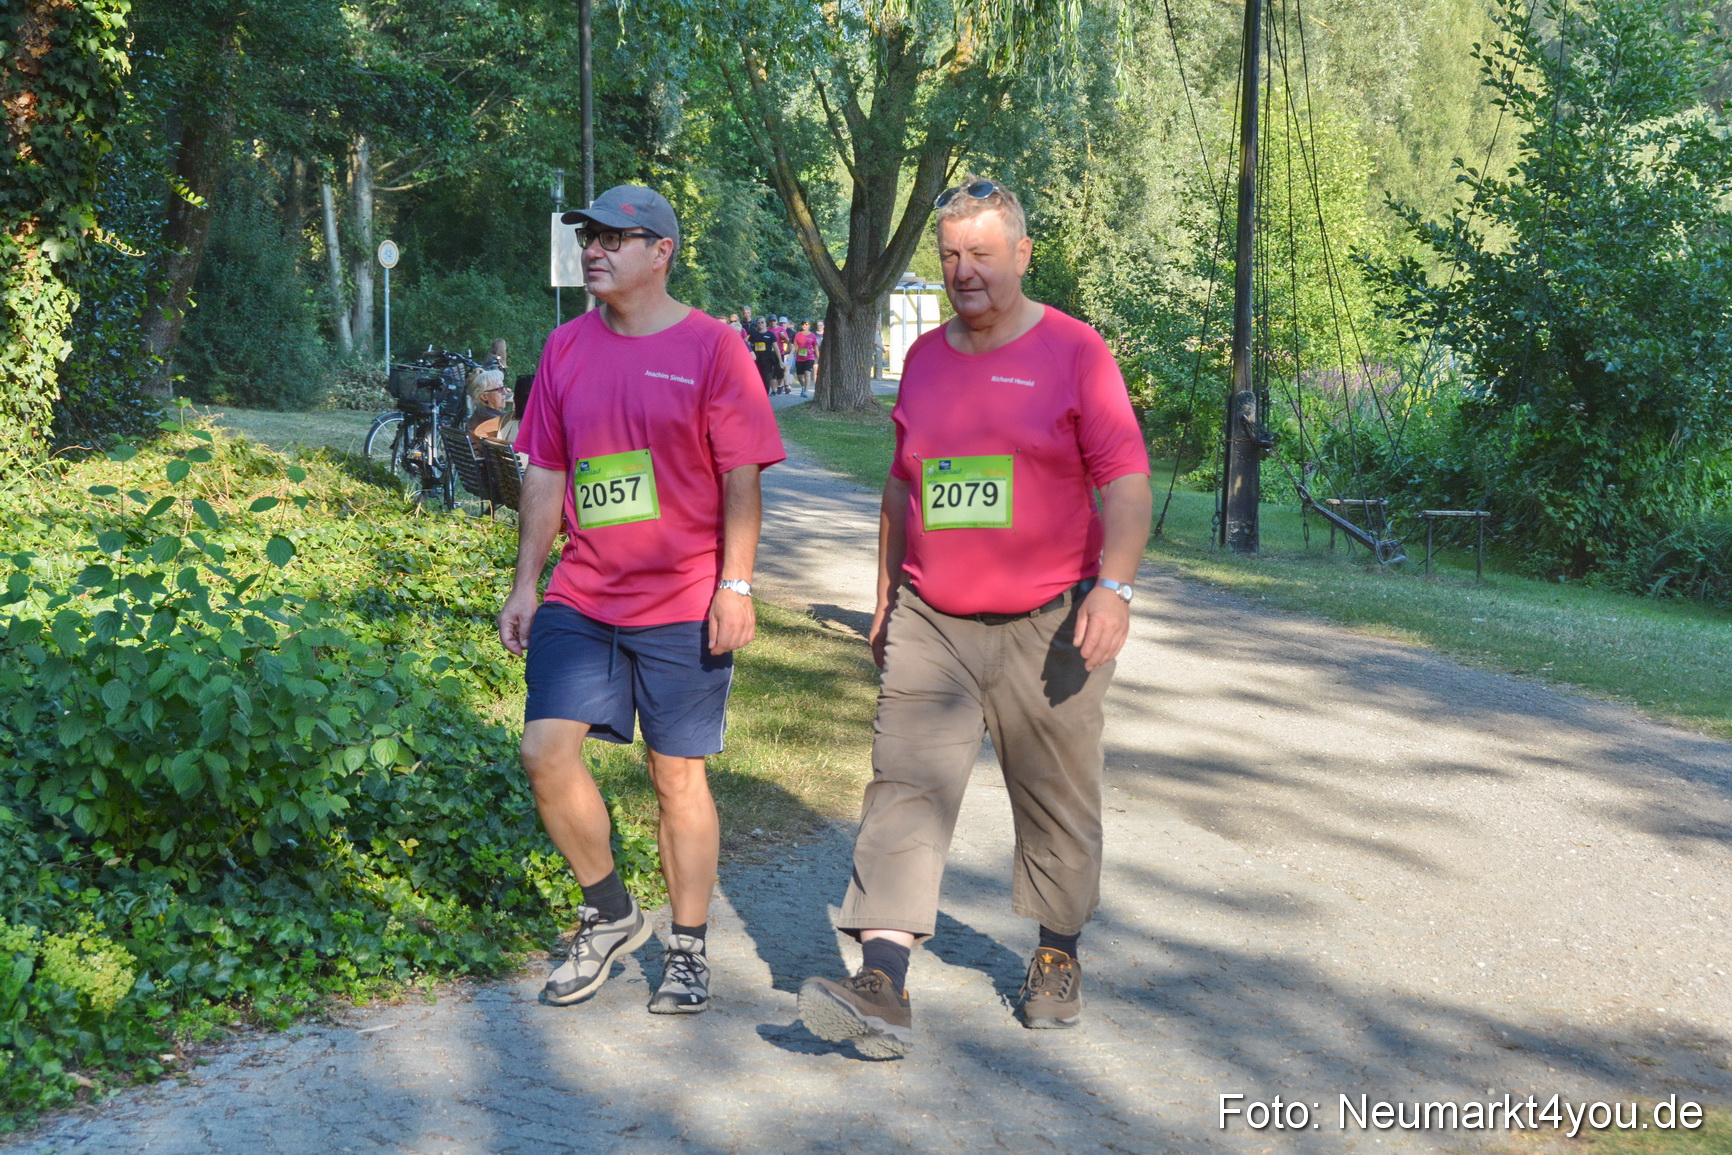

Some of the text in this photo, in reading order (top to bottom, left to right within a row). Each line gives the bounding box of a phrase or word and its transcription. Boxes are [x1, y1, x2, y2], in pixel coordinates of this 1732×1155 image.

[644, 370, 695, 386] Joachim Simbeck
[579, 476, 641, 510] 2057
[931, 481, 999, 509] 2079
